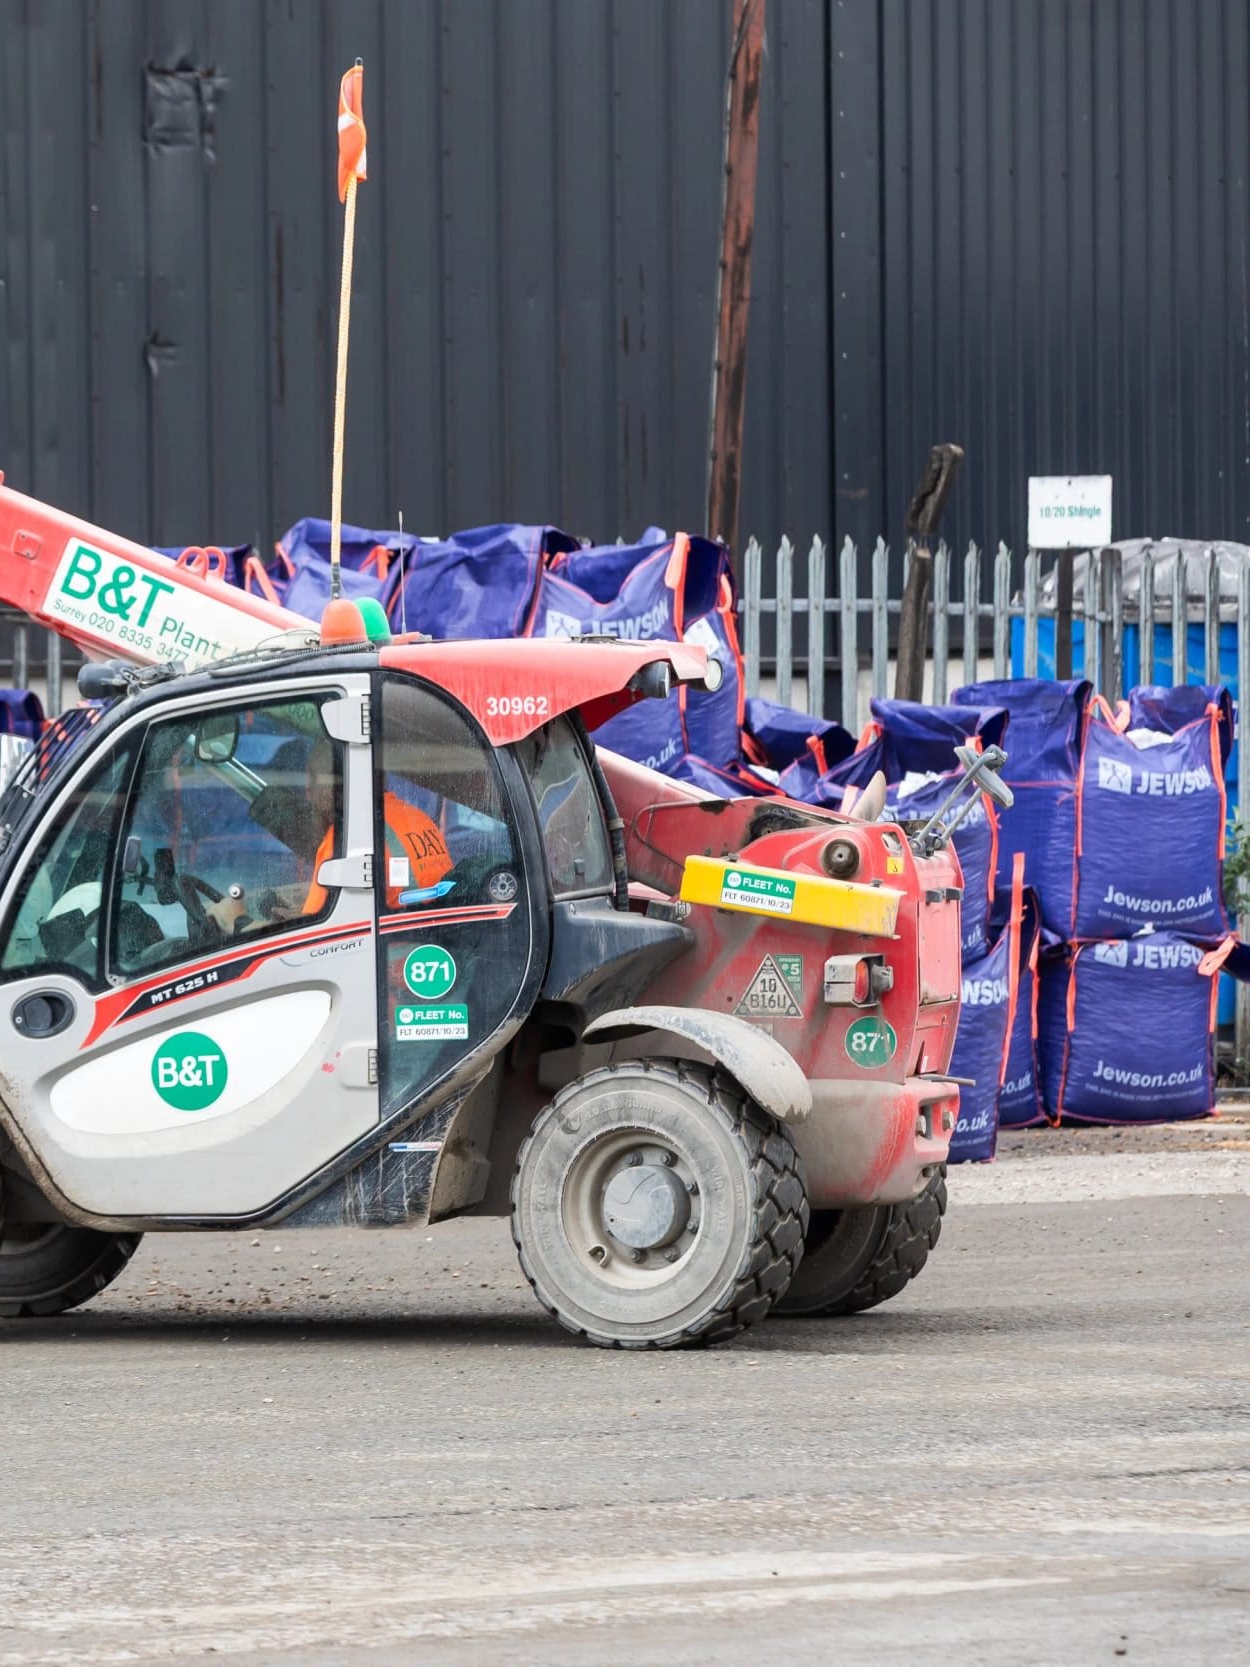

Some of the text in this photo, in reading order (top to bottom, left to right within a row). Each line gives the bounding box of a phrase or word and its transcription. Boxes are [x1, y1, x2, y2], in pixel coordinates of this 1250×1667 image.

[1067, 505, 1102, 519] Shingle
[59, 545, 222, 660] B&T Plant
[53, 598, 190, 663] Surrey 020 8335 3477
[486, 696, 548, 717] 30962
[639, 738, 676, 769] o.uk
[1136, 764, 1212, 796] JEWSON
[724, 891, 738, 901] FLT
[742, 877, 774, 891] FLEET
[775, 882, 792, 895] No.
[1103, 885, 1213, 914] Jewson.co.uk
[410, 960, 451, 983] 871
[151, 971, 219, 1005] MT 625 H
[414, 1010, 446, 1021] FLEET
[448, 1009, 465, 1020] No.
[399, 1028, 412, 1037] FLT
[157, 1054, 221, 1089] B&T
[1092, 1059, 1204, 1088] Jewson.co.uk
